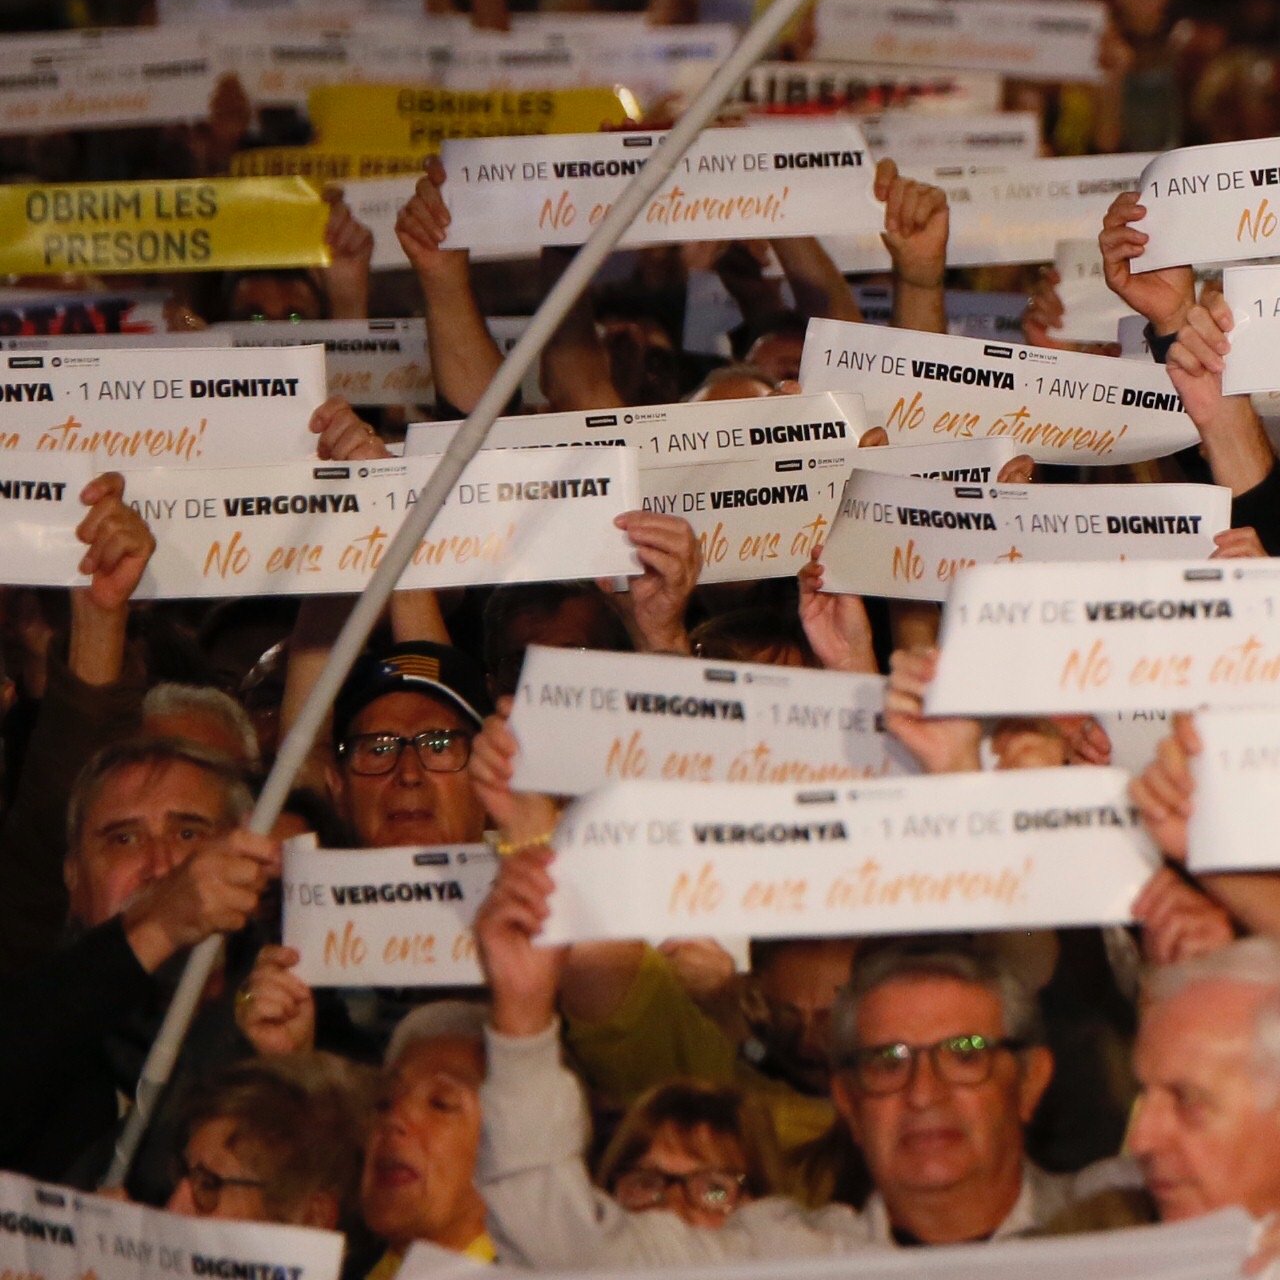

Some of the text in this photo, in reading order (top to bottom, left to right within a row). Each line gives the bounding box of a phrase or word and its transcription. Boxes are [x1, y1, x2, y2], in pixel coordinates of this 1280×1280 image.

[462, 163, 469, 182] 1
[477, 164, 515, 184] ANY
[523, 162, 547, 181] DE
[684, 154, 691, 172] 1
[698, 155, 736, 173] ANY
[743, 153, 768, 172] DE
[774, 151, 862, 169] DIGNITAT
[1151, 179, 1158, 197] 1
[1168, 175, 1209, 196] ANY
[1217, 171, 1245, 191] DE
[26, 189, 219, 223] OBRIM LES
[539, 191, 576, 229] No
[1236, 198, 1275, 240] No
[43, 228, 211, 268] PRESONS
[825, 348, 832, 366] 1
[837, 351, 876, 371] ANY
[882, 356, 906, 376] DE
[912, 360, 1014, 390] VERGONYA
[1036, 377, 1043, 394] 1
[1049, 379, 1089, 400] ANY
[1093, 384, 1118, 404] DE
[887, 392, 924, 429] No
[933, 411, 981, 438] ens
[1086, 600, 1232, 621] VERGONYA
[694, 822, 847, 844] VERGONYA
[295, 880, 464, 906] DE VERGONYA
[189, 1252, 302, 1280] DIGNITAT
